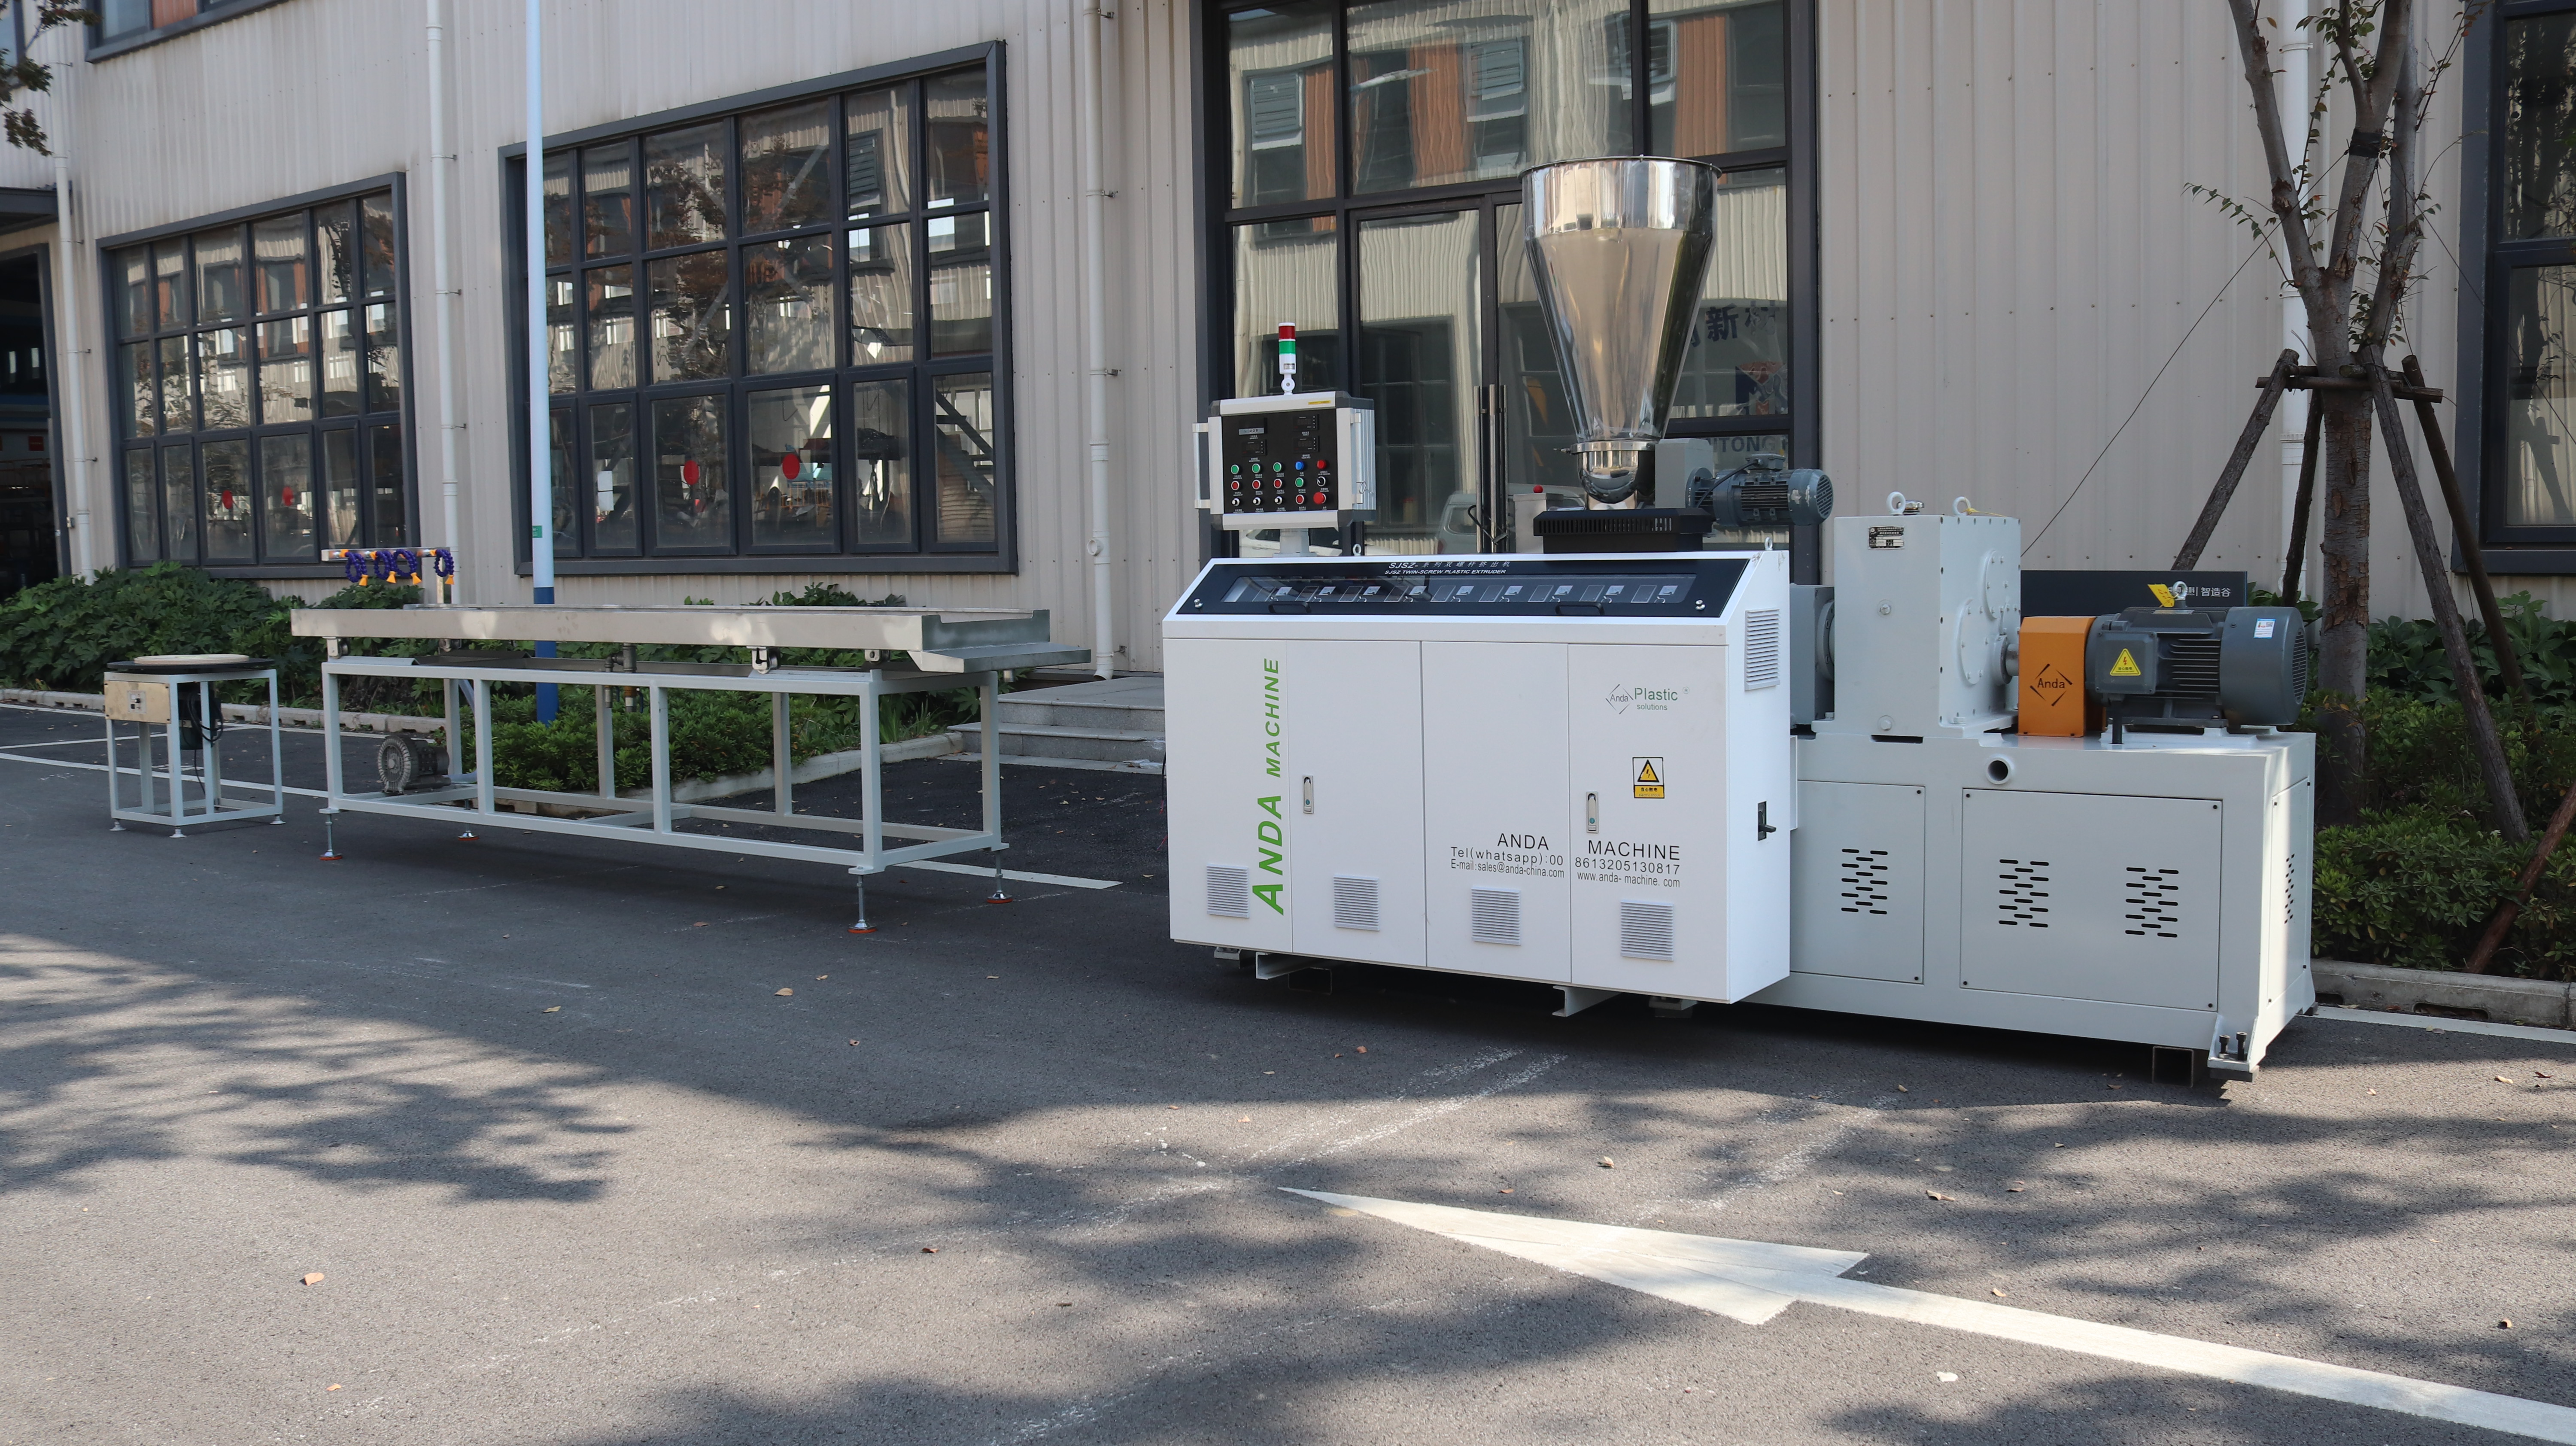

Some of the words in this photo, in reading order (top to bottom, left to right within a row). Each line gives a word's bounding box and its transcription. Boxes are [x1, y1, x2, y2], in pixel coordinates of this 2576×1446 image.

[2201, 587, 2231, 597] 智造谷
[2037, 677, 2065, 688] Anda
[1610, 694, 1629, 702] Anda
[1634, 687, 1678, 701] Plastic
[1264, 658, 1281, 778] MACHINE
[1497, 833, 1549, 851] ANDA
[1589, 840, 1680, 860] MACHINE
[1252, 796, 1284, 915] ANDA
[1575, 857, 1680, 875] 8613205130817
